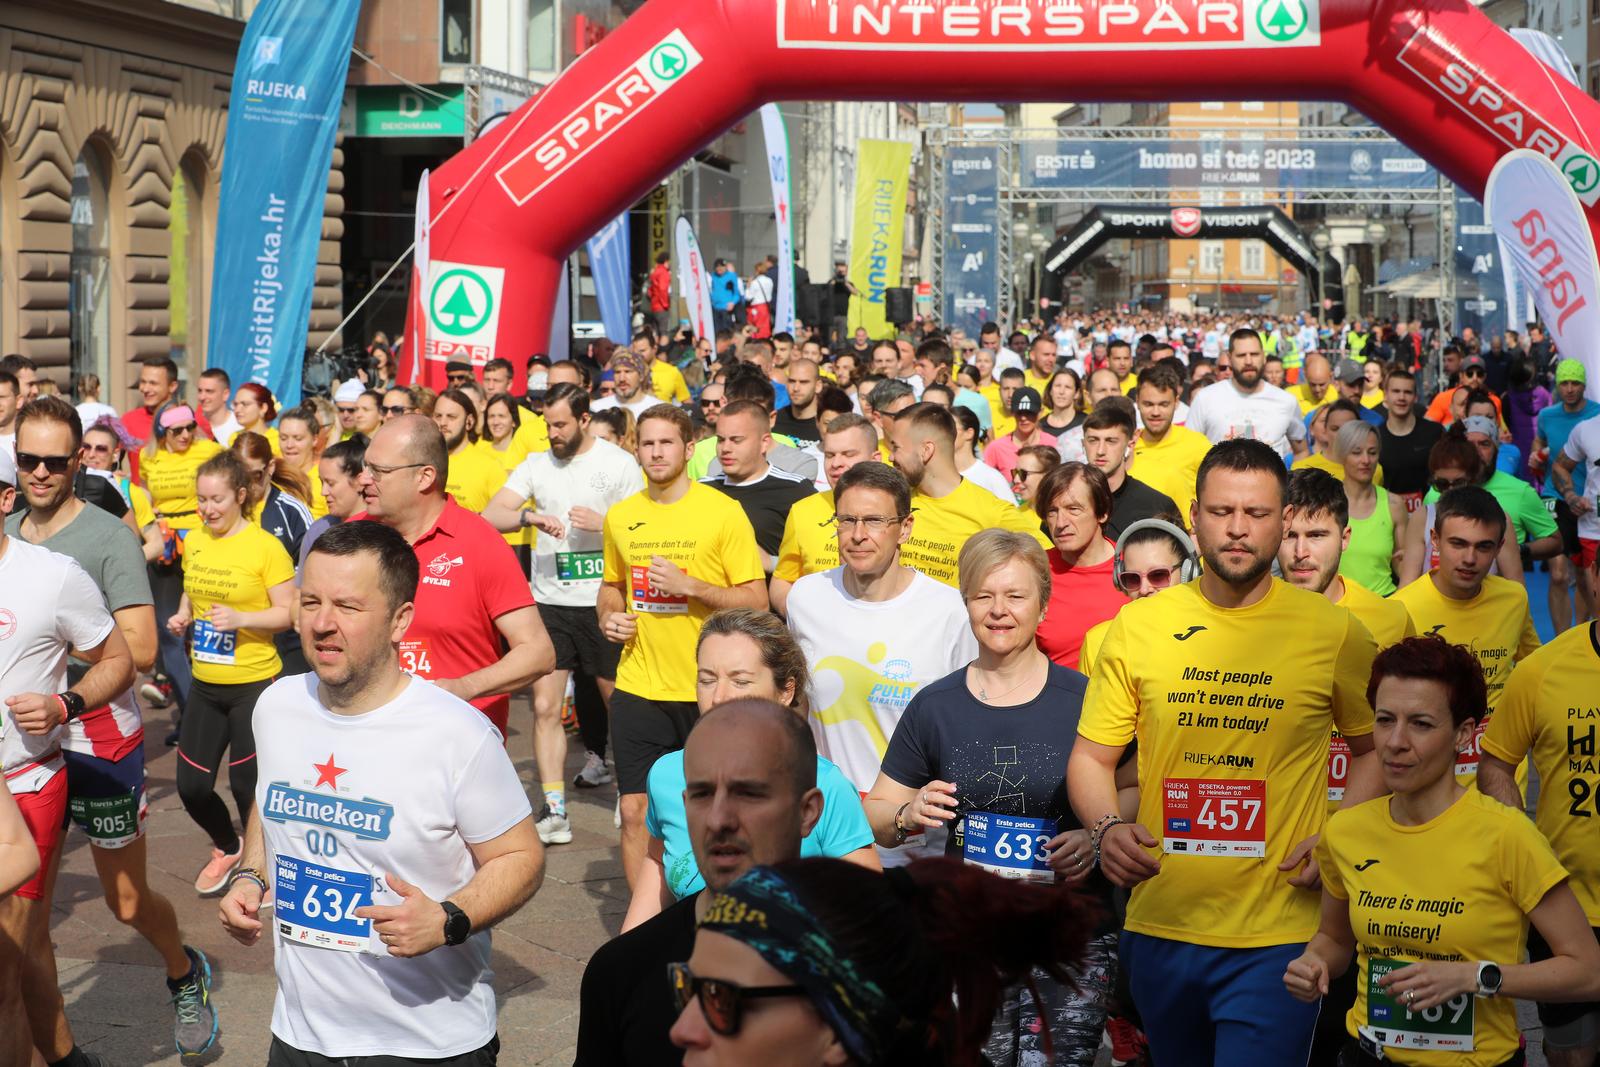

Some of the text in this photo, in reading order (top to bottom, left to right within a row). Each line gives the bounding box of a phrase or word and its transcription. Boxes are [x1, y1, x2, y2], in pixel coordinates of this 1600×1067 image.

[828, 4, 1239, 36] INTERSPAR
[247, 80, 306, 100] RIJEKA
[1440, 63, 1559, 156] SPAR
[381, 122, 441, 130] DEICHMANN
[535, 74, 650, 171] SPAR
[952, 160, 981, 170] ERSTE
[1036, 155, 1079, 169] ERSTE
[1139, 149, 1197, 169] homo
[1202, 150, 1221, 169] si
[1264, 149, 1316, 169] 2023
[1111, 214, 1260, 226] SPORT VISION
[868, 178, 897, 304] RIJEKARUN
[962, 251, 984, 272] A1
[1471, 252, 1493, 273] A1
[629, 541, 660, 549] Runners
[824, 543, 839, 552] Mos
[928, 539, 955, 552] people
[920, 553, 940, 564] even
[942, 554, 958, 567] driv
[928, 566, 954, 580] today!
[203, 630, 235, 652] 775
[1480, 646, 1508, 660] magic
[1182, 667, 1273, 687] Most people
[871, 683, 912, 699] PULA
[1167, 690, 1285, 710] won't even drive
[1178, 712, 1270, 734] 21 km today!
[1184, 752, 1255, 768] RIJEKARUN
[1168, 790, 1188, 799] RUN
[268, 789, 381, 832] Heineken
[1197, 799, 1262, 831] 457
[93, 814, 126, 833] 905
[968, 819, 987, 830] RUN
[996, 819, 1013, 827] Erste
[306, 829, 337, 857] 0.0
[994, 832, 1052, 861] 633
[278, 867, 297, 880] RUN
[305, 867, 346, 882] Erste petica
[302, 884, 368, 926] 634
[1358, 890, 1465, 917] There is magic
[300, 930, 309, 939] A1
[1367, 918, 1441, 944] in misery!
[1383, 944, 1403, 957] ask
[1405, 947, 1424, 959] any
[1395, 1034, 1405, 1043] A1
